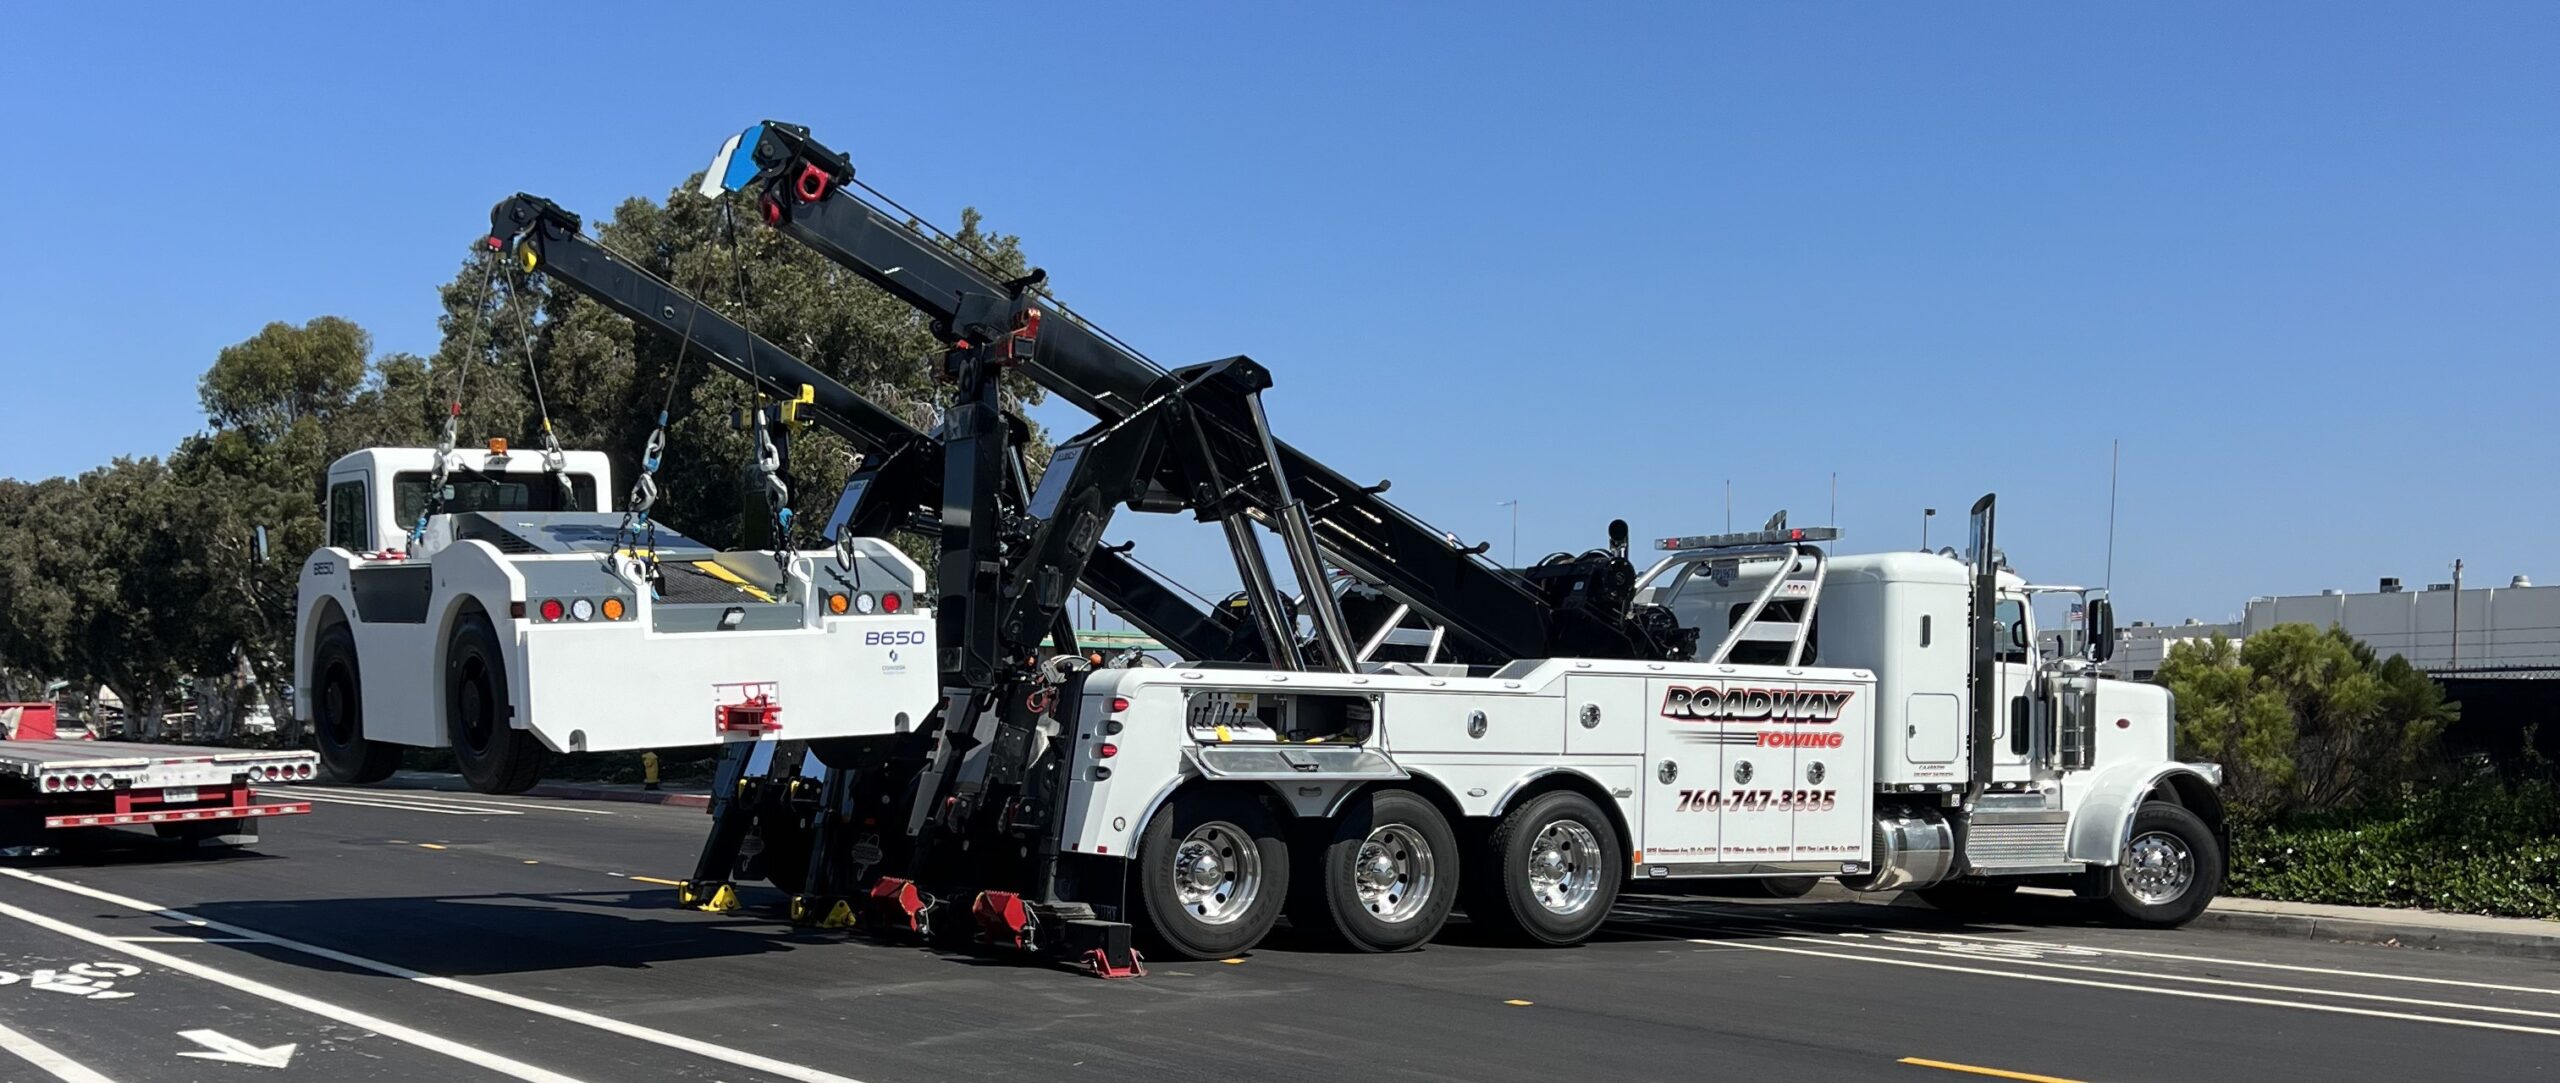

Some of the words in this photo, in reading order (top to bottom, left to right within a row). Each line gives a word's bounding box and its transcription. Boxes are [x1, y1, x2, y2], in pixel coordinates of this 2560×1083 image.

[314, 562, 334, 575] B650
[865, 631, 925, 645] B650
[1661, 686, 1854, 724] ROADWAY
[1756, 731, 1844, 749] TOWING
[1676, 789, 1837, 812] 760-747-3335
